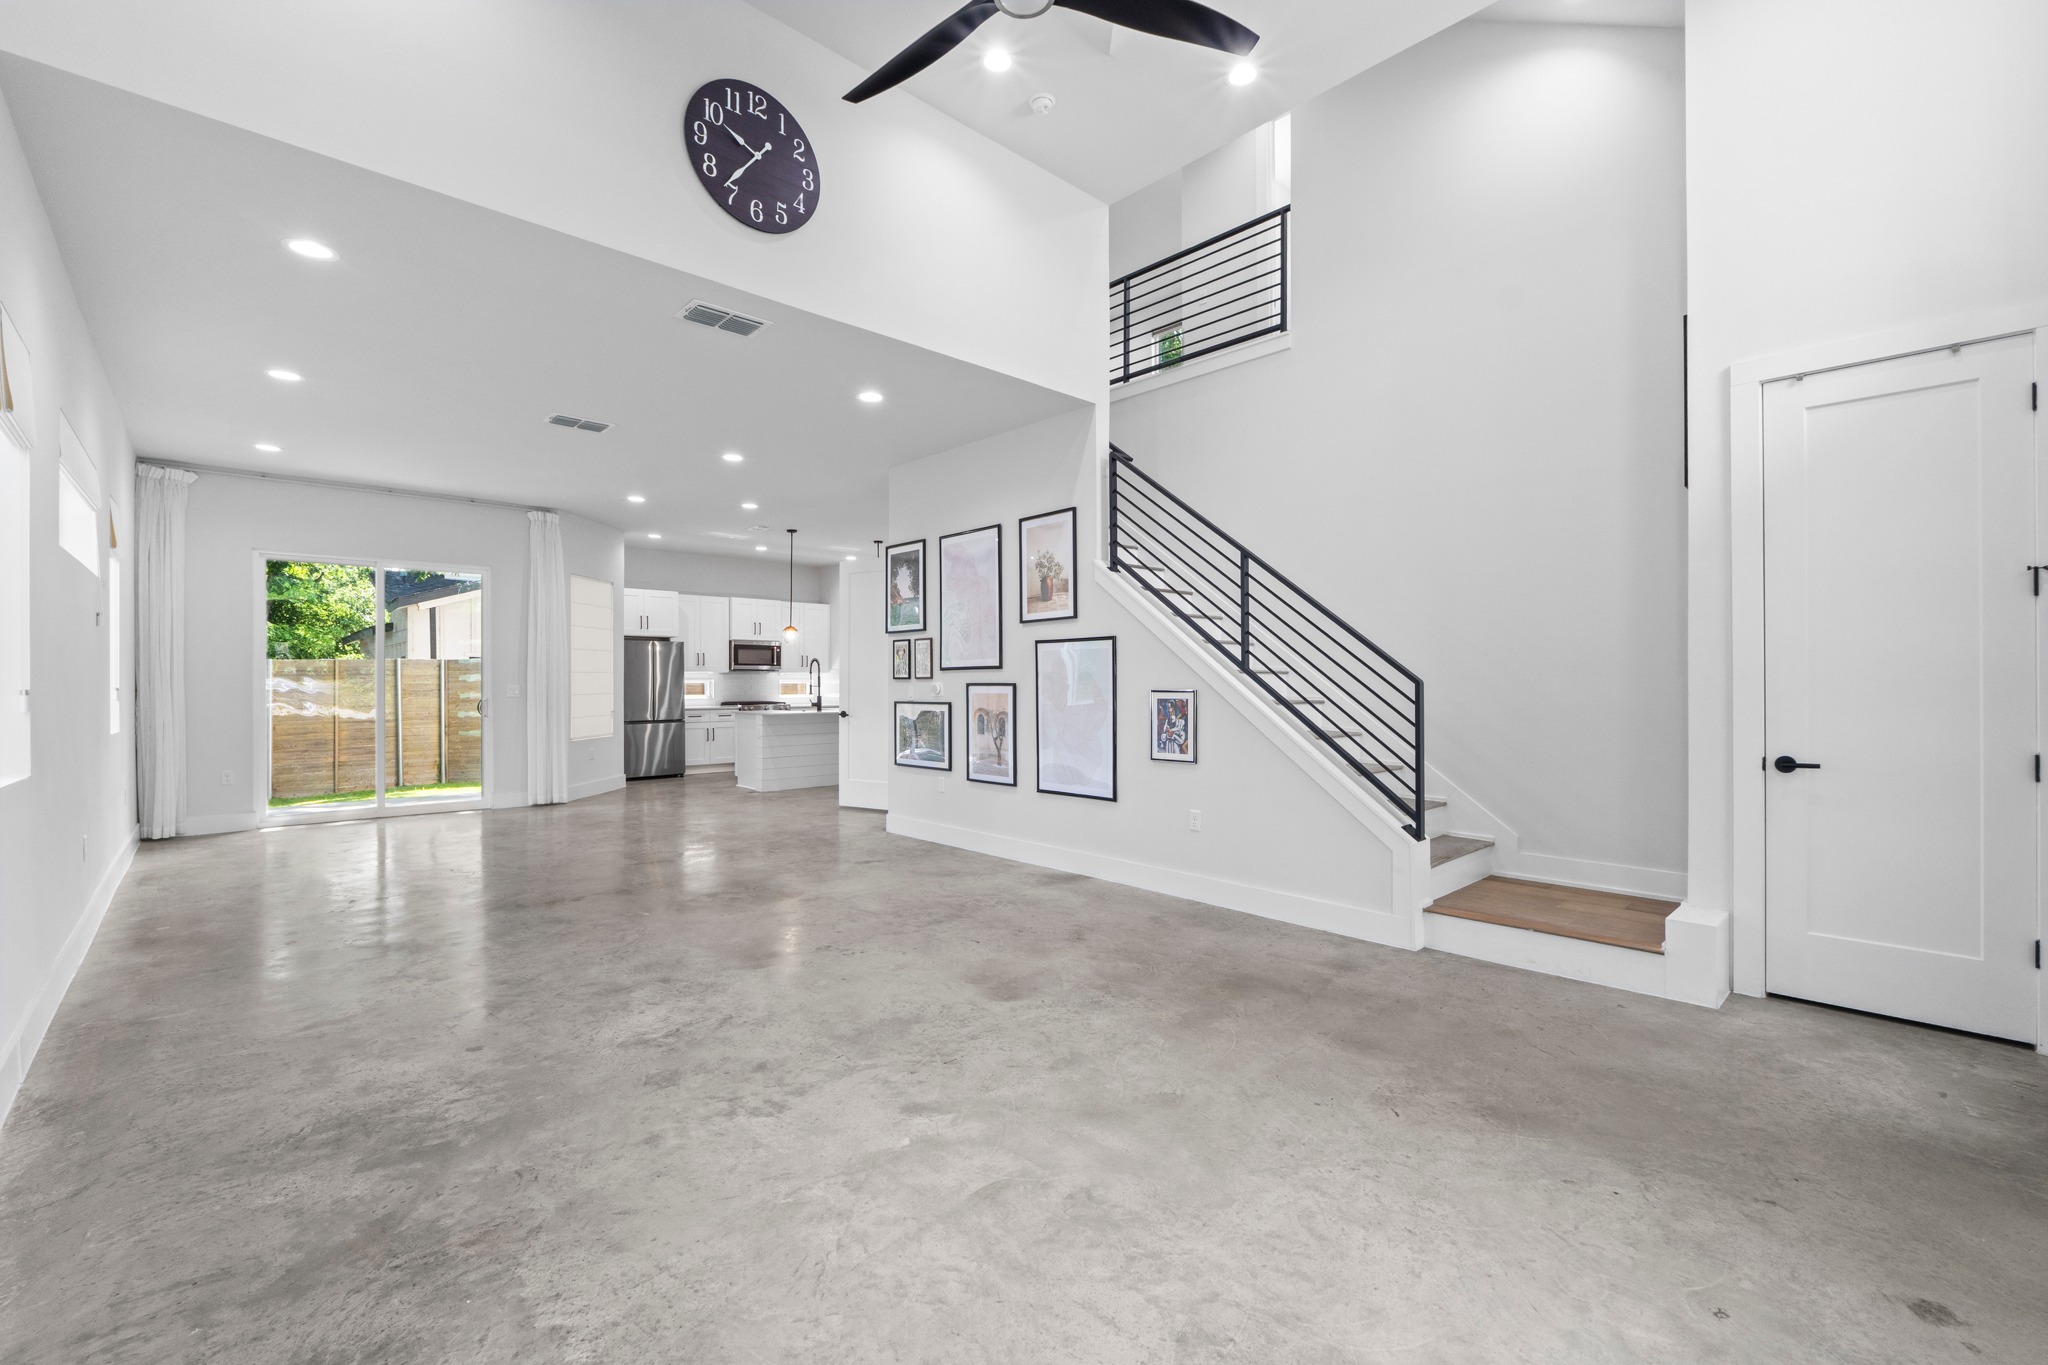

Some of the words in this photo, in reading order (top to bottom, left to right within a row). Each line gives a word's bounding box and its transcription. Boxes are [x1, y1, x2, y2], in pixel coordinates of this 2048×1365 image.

[703, 98, 723, 125] 10
[725, 87, 742, 115] 11
[747, 91, 767, 119] 12
[694, 121, 707, 145] 9
[779, 114, 786, 136] 1
[793, 139, 805, 162] 2
[703, 153, 717, 177] 8
[802, 169, 814, 191] 3
[724, 182, 738, 205] 7
[793, 193, 805, 214] 4
[750, 200, 763, 222] 6
[776, 202, 787, 224] 5
